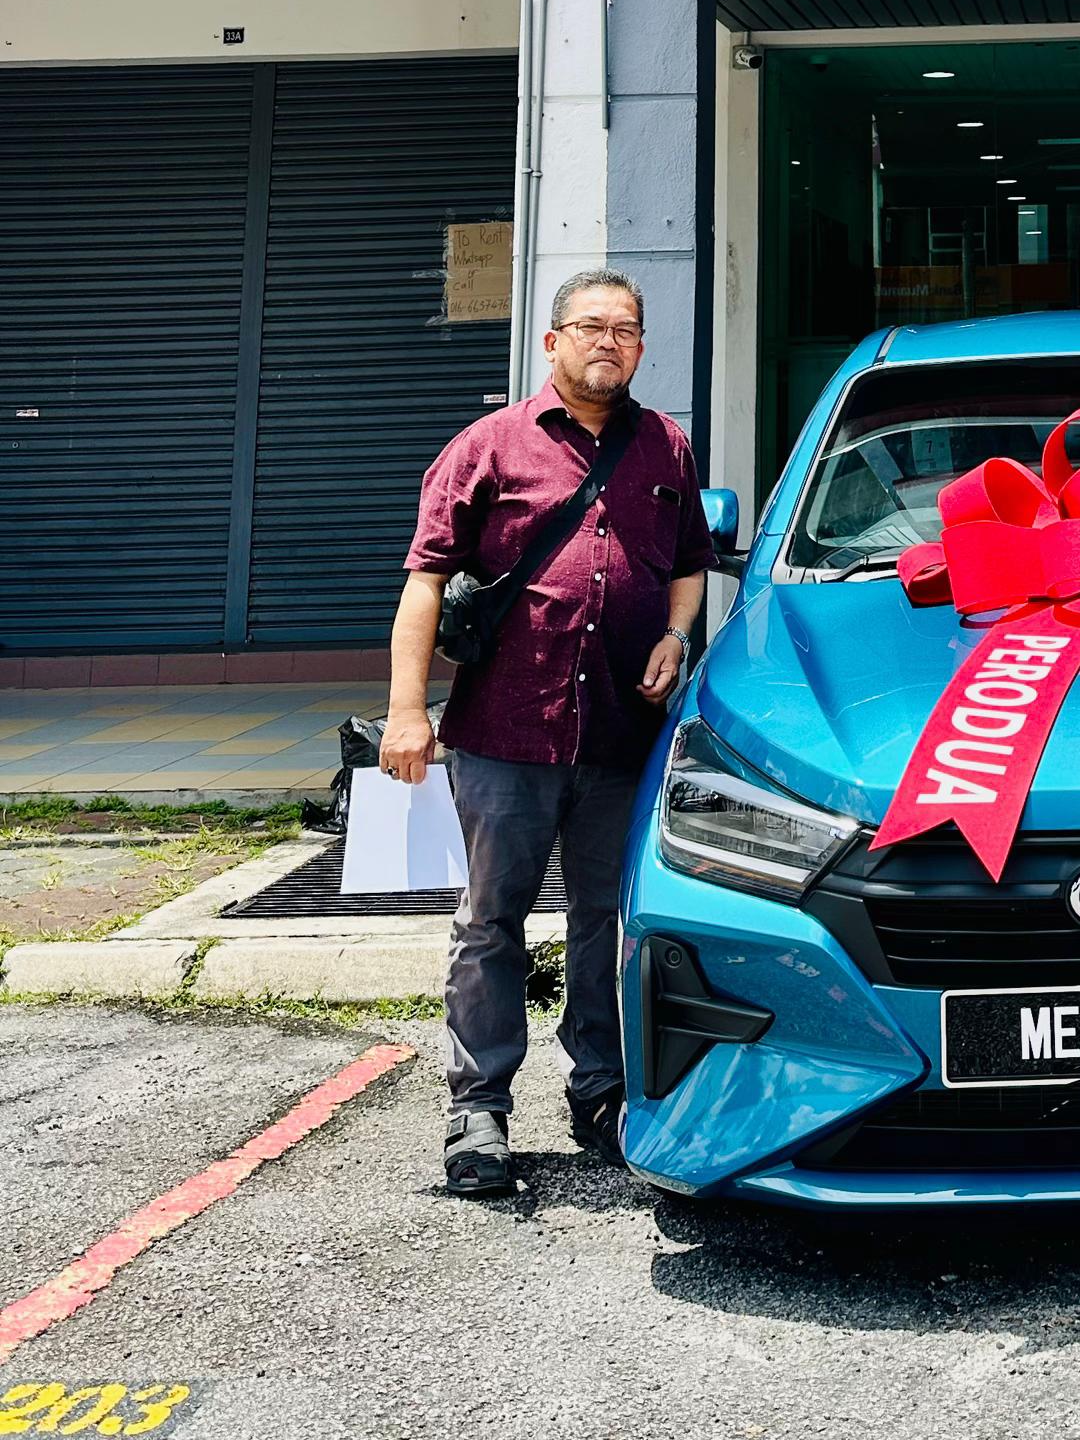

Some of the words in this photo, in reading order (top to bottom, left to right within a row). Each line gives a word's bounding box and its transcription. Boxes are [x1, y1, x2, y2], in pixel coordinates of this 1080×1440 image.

[225, 31, 242, 41] 33A
[480, 225, 503, 246] Rent
[916, 634, 1071, 804] PERODUA
